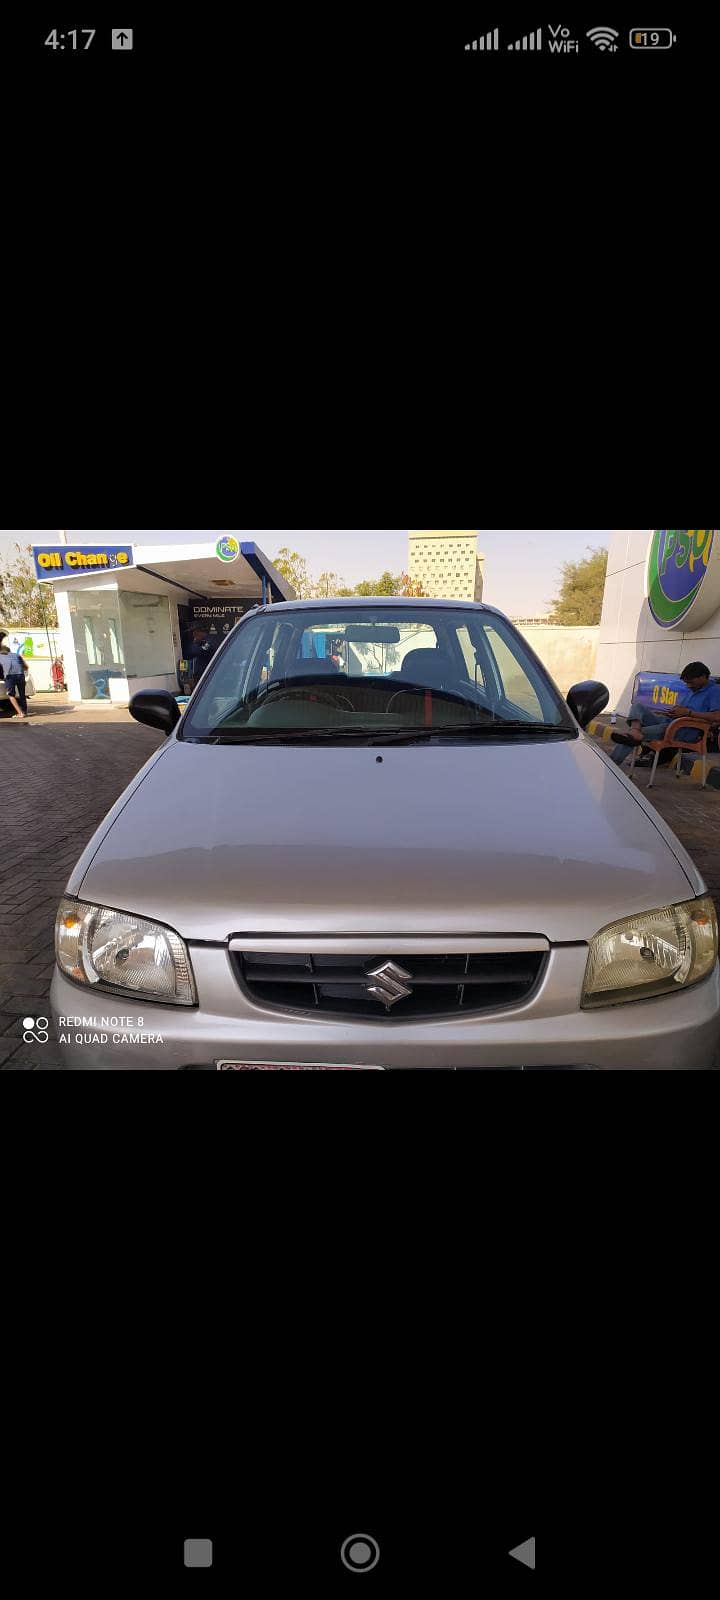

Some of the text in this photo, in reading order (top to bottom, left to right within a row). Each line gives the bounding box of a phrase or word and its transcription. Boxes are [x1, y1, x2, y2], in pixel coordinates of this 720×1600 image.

[37, 551, 129, 568] Oil Change
[660, 686, 679, 706] Star
